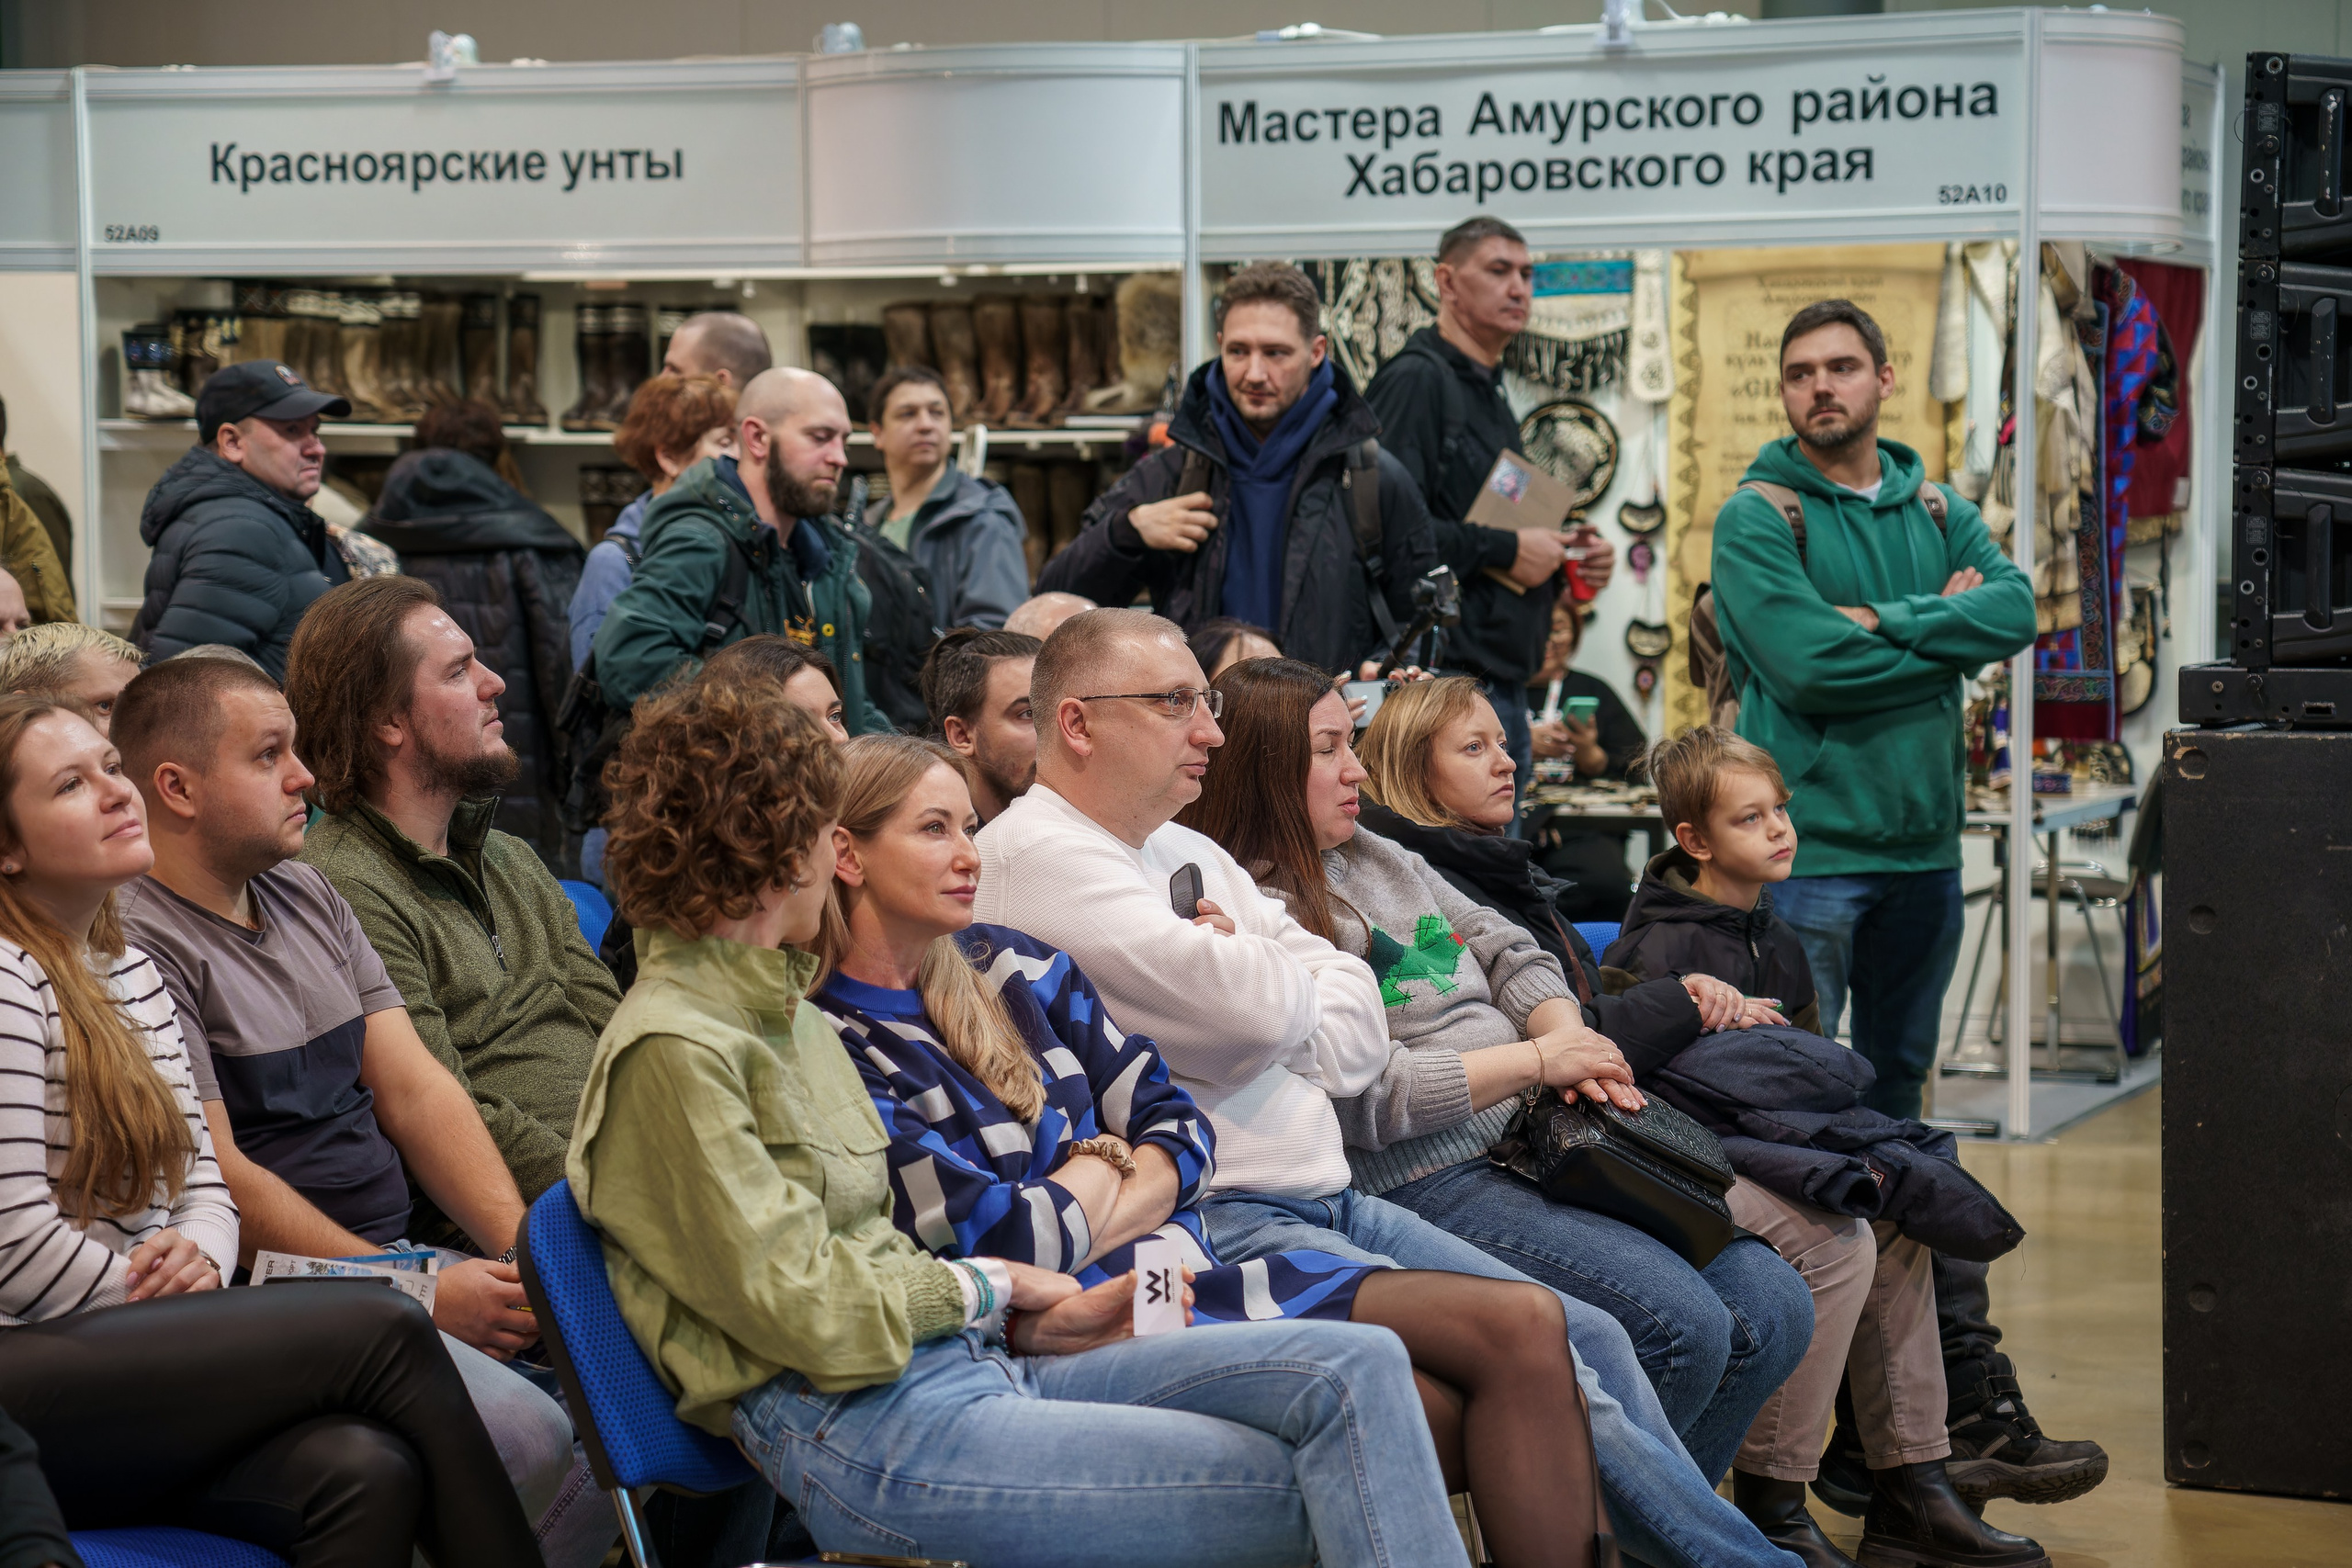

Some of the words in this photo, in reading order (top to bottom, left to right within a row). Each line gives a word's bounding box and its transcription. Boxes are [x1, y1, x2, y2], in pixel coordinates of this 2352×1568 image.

[1218, 99, 1442, 151] Мастера
[1467, 89, 1765, 145] Амурского
[1792, 73, 1999, 136] района
[210, 141, 548, 193] Красноярские
[559, 147, 684, 193] унты
[1343, 148, 1727, 206] Хабаровского
[1747, 145, 1875, 196] края
[1938, 182, 2008, 205] 52A10
